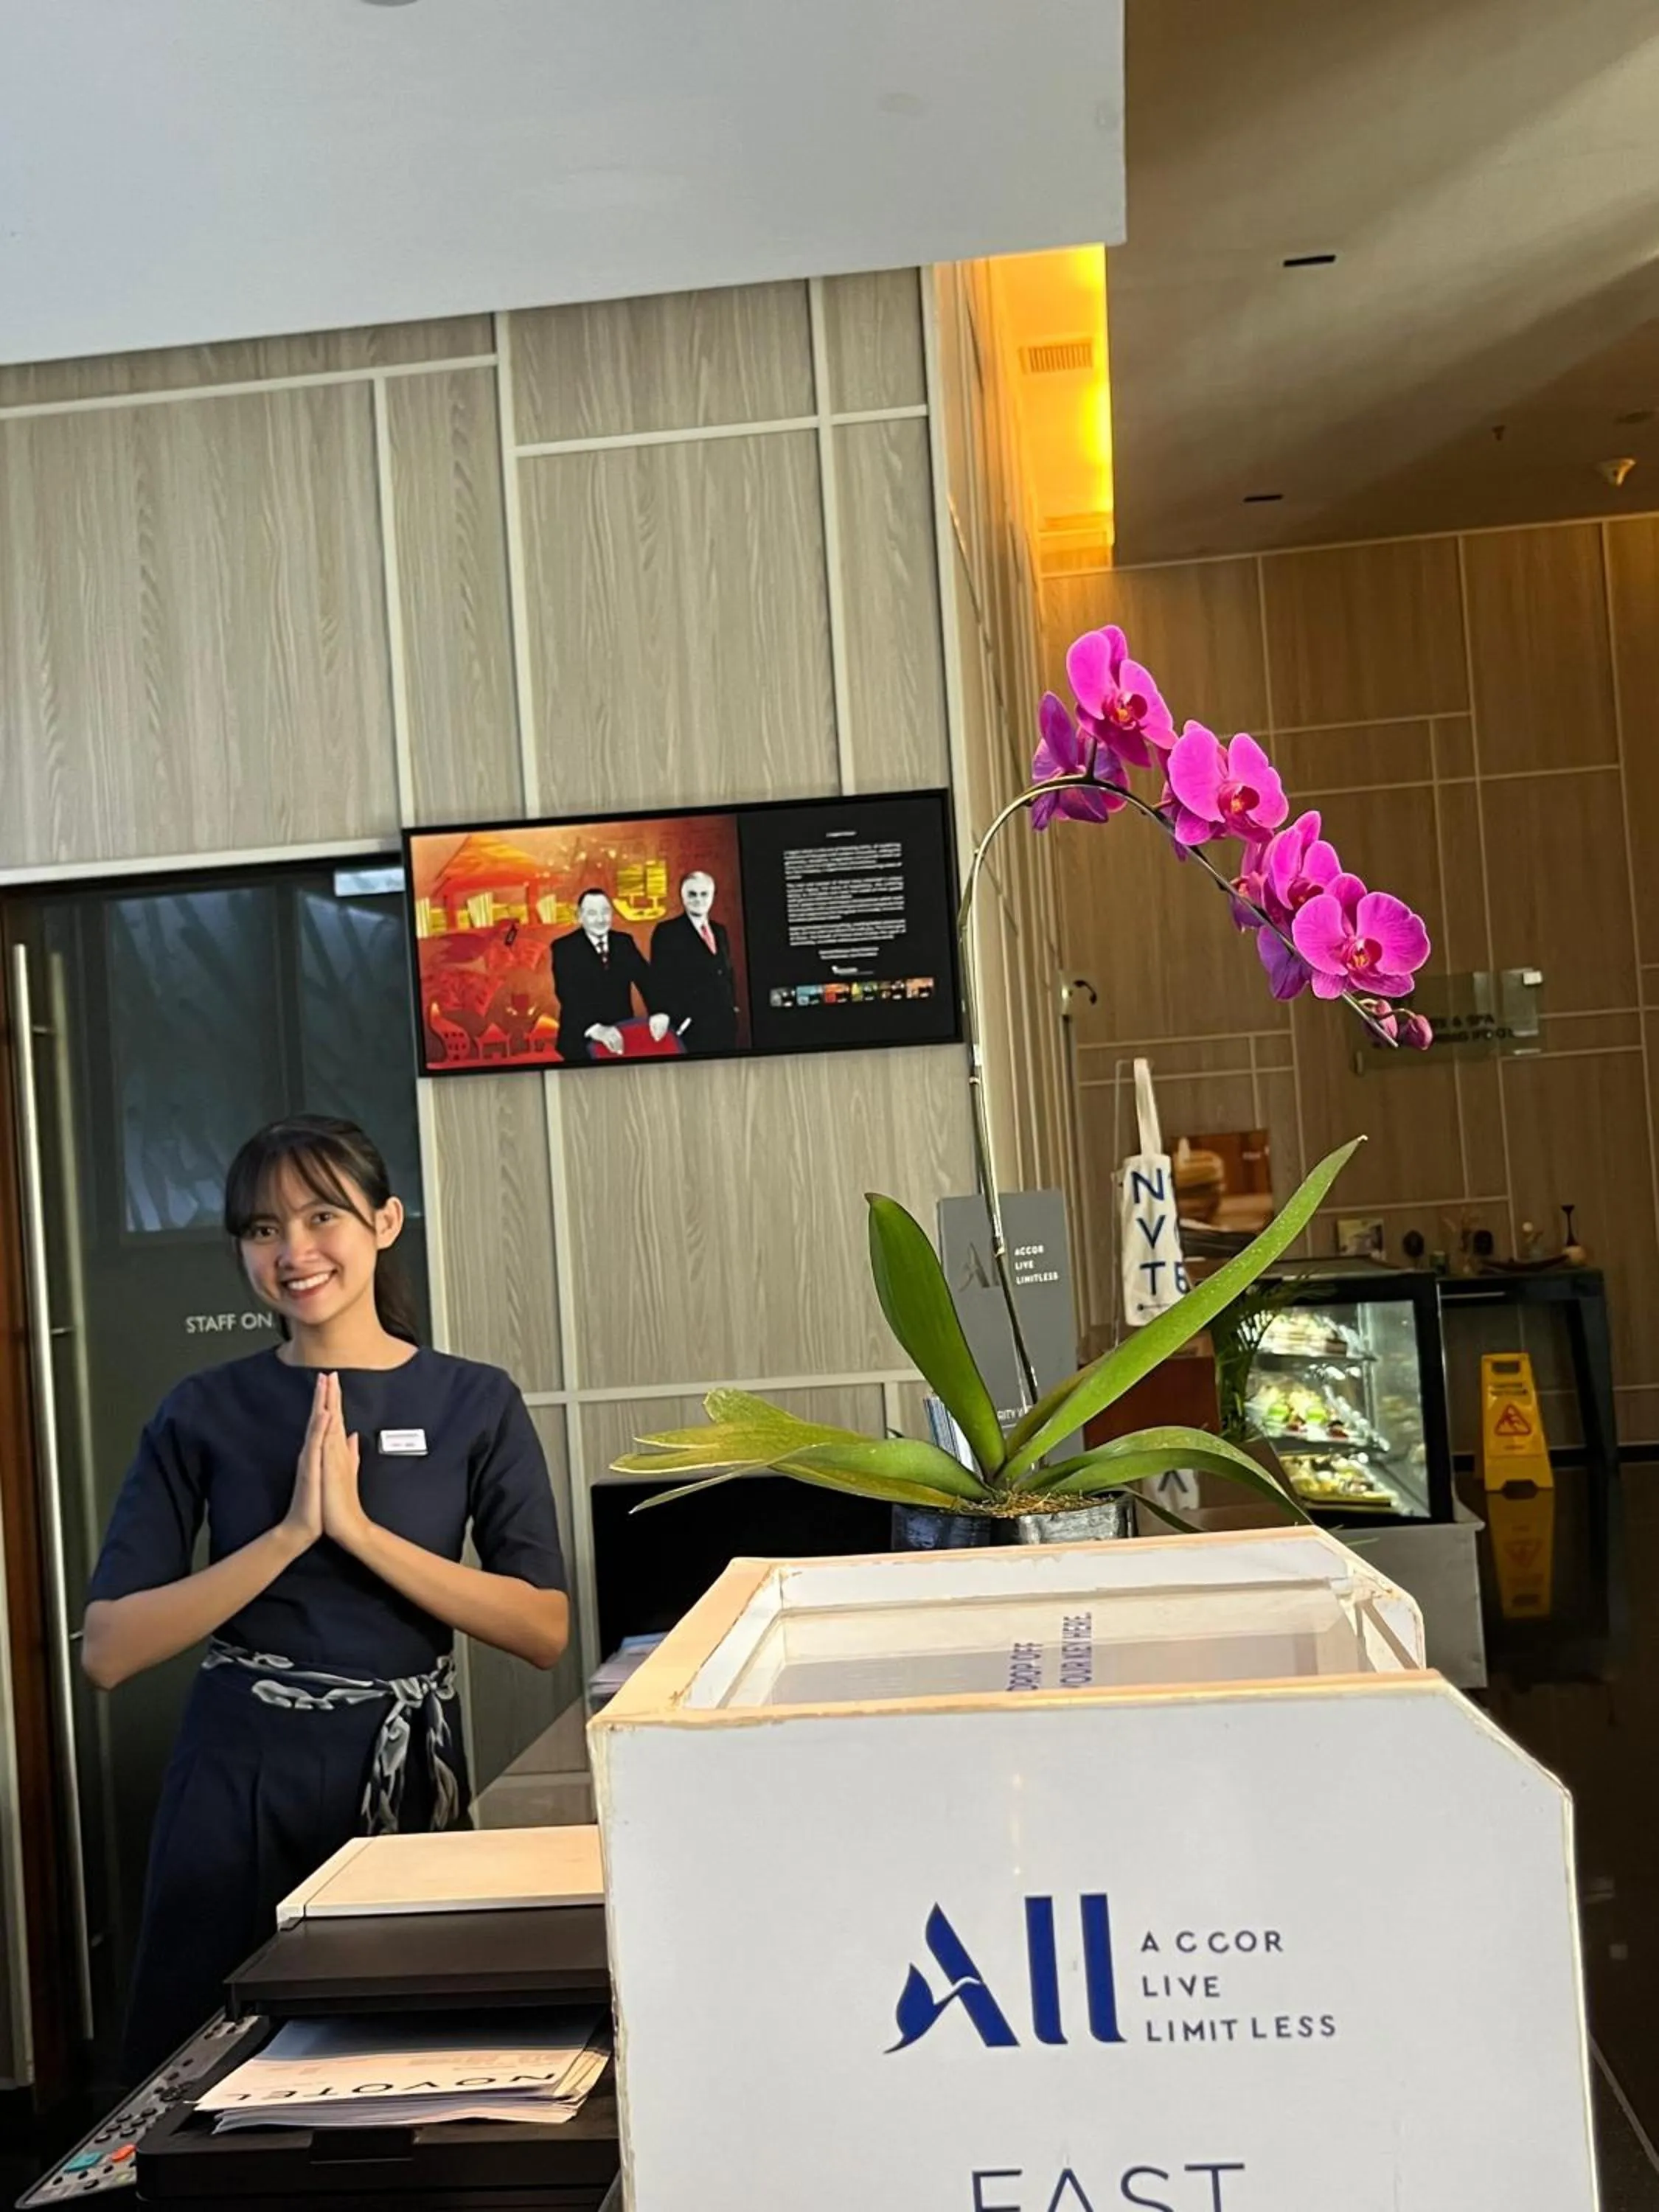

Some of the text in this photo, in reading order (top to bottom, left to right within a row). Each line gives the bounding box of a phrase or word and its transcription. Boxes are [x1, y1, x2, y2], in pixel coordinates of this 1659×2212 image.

[1014, 1245, 1044, 1256] ACCOR
[1015, 1259, 1034, 1270] LIVE
[1015, 1271, 1059, 1285] LIMITLESS
[186, 1311, 273, 1334] STAFF ON
[1140, 1930, 1284, 1954] ACCOR
[1142, 1975, 1222, 1998] LIVE
[226, 2072, 557, 2101] NOVOTEL
